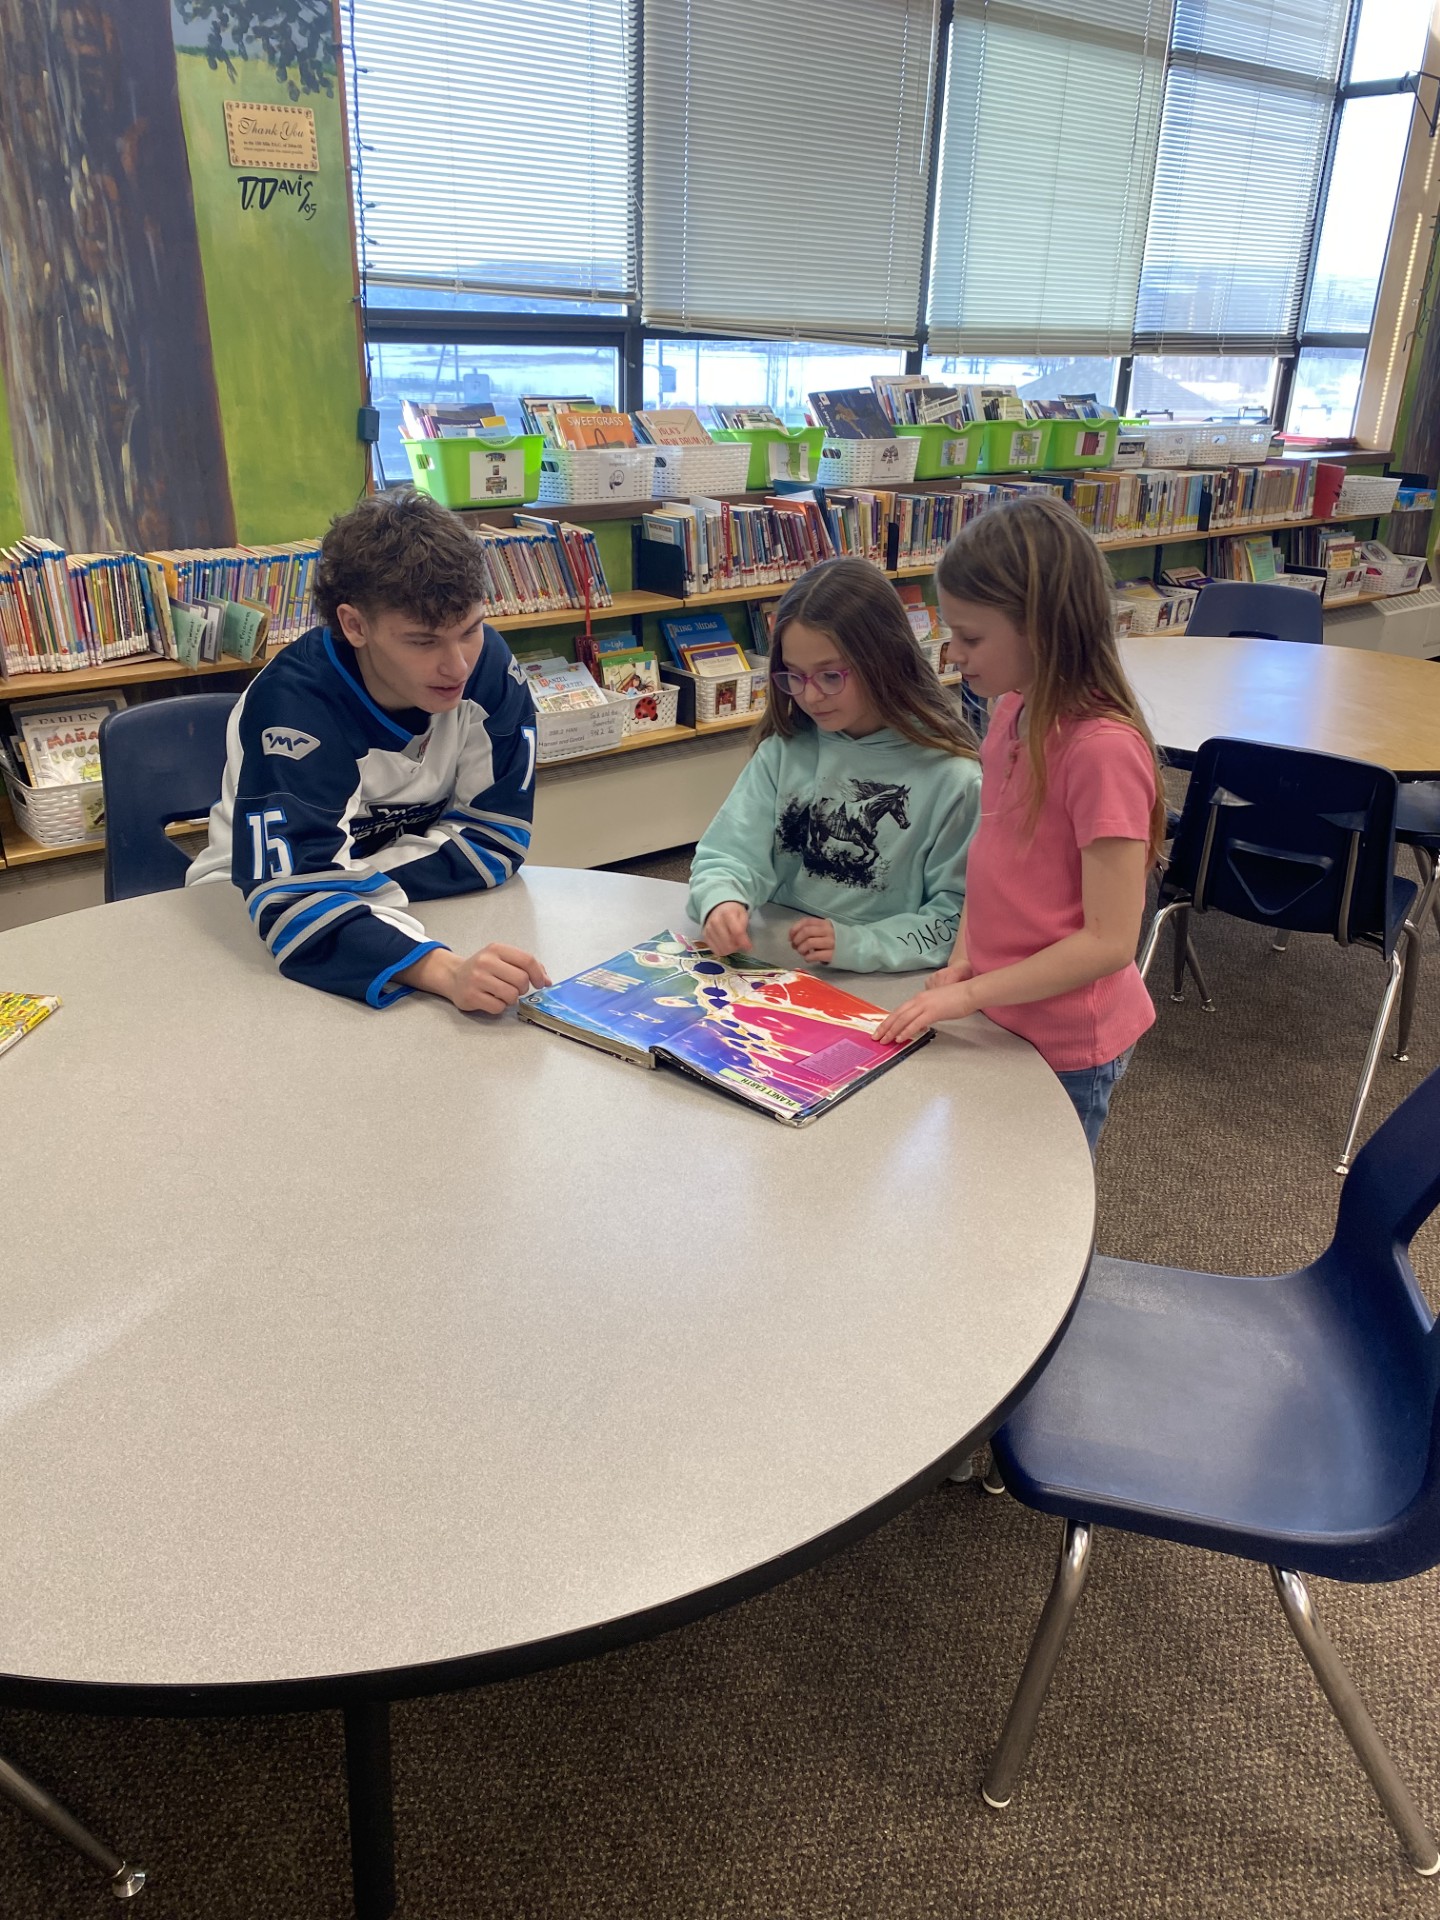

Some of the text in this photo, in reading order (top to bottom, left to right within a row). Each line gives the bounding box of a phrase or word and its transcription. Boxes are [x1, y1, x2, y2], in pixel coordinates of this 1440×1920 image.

[238, 117, 304, 140] Thank You
[566, 416, 624, 426] SWEETGRASS
[658, 426, 681, 436] ISLA'S
[660, 436, 700, 445] NEW DRUM
[46, 727, 99, 750] MAÑA
[245, 807, 295, 880] 15
[741, 1077, 796, 1107] PLANET EARTH
